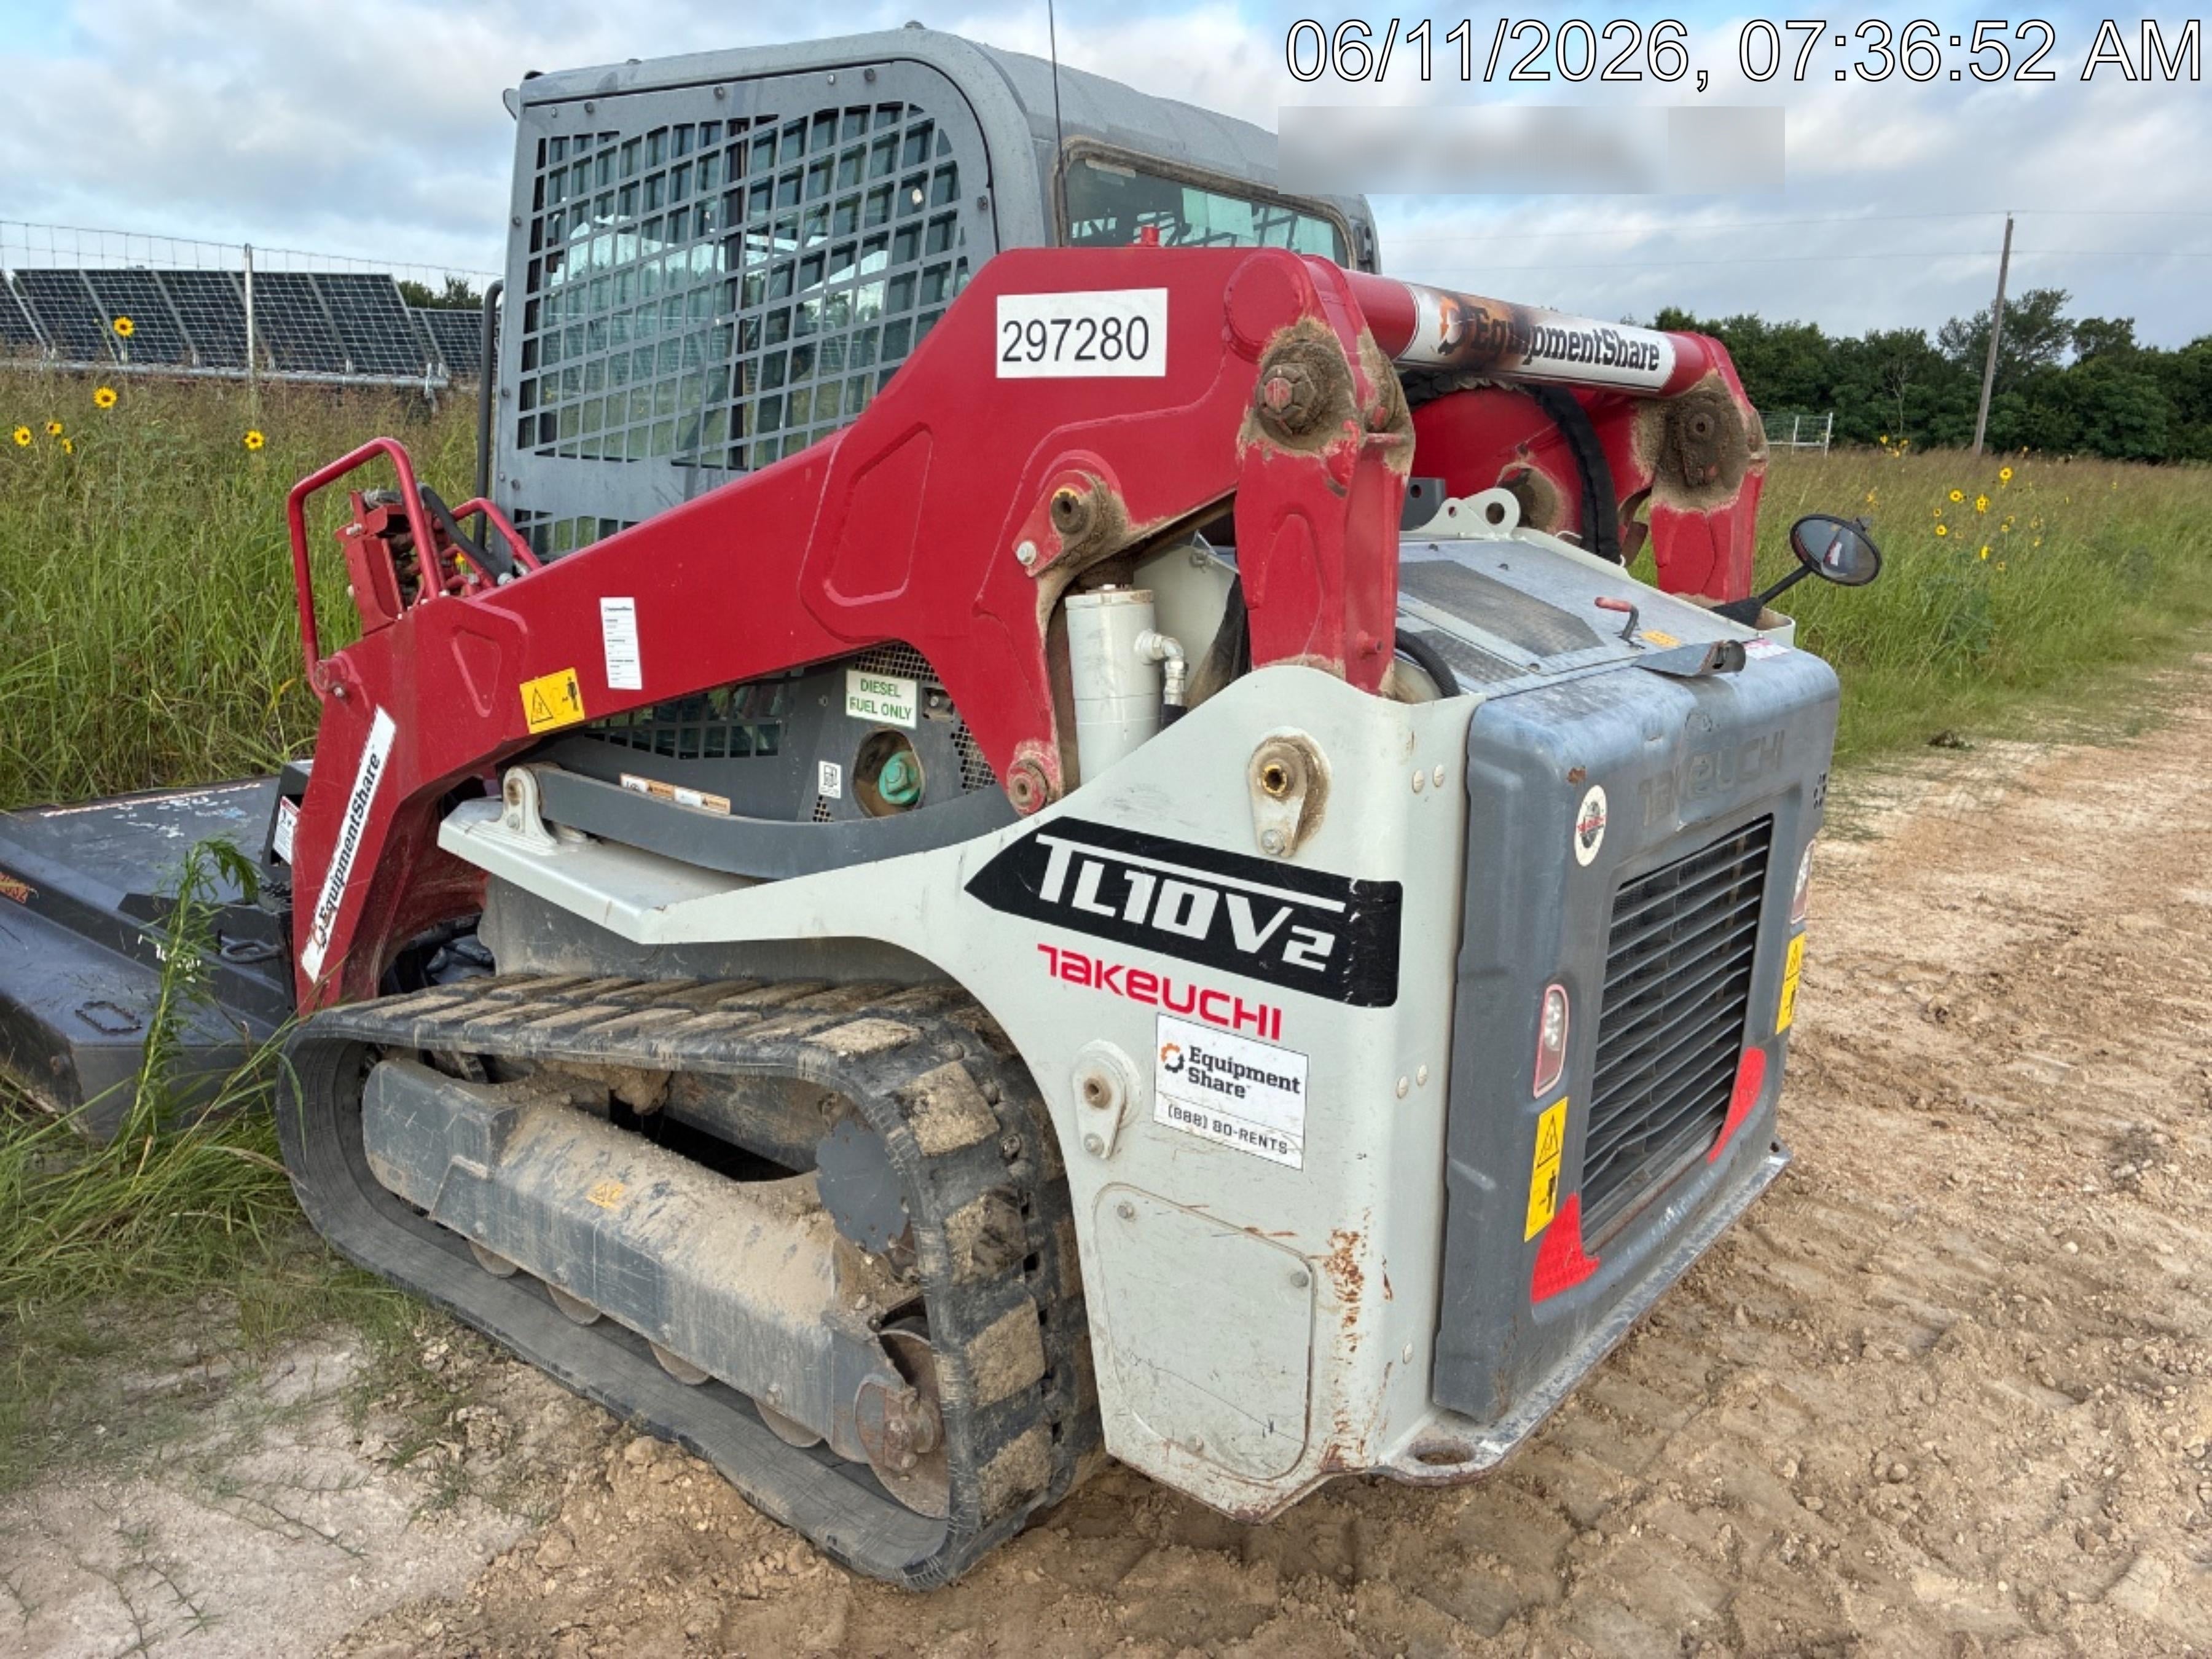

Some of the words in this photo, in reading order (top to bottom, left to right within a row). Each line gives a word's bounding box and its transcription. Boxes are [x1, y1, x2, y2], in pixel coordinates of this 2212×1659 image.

[1002, 316, 1150, 362] 297280
[849, 697, 878, 714] FUEL
[881, 704, 912, 721] ONLY
[860, 678, 901, 698] DIESEL
[318, 753, 380, 923] EquipmentShare
[1188, 1067, 1246, 1099] Share
[1189, 1045, 1300, 1094] Equipment
[1167, 1104, 1208, 1129] (888)
[1212, 1120, 1287, 1155] 80-RENTS
